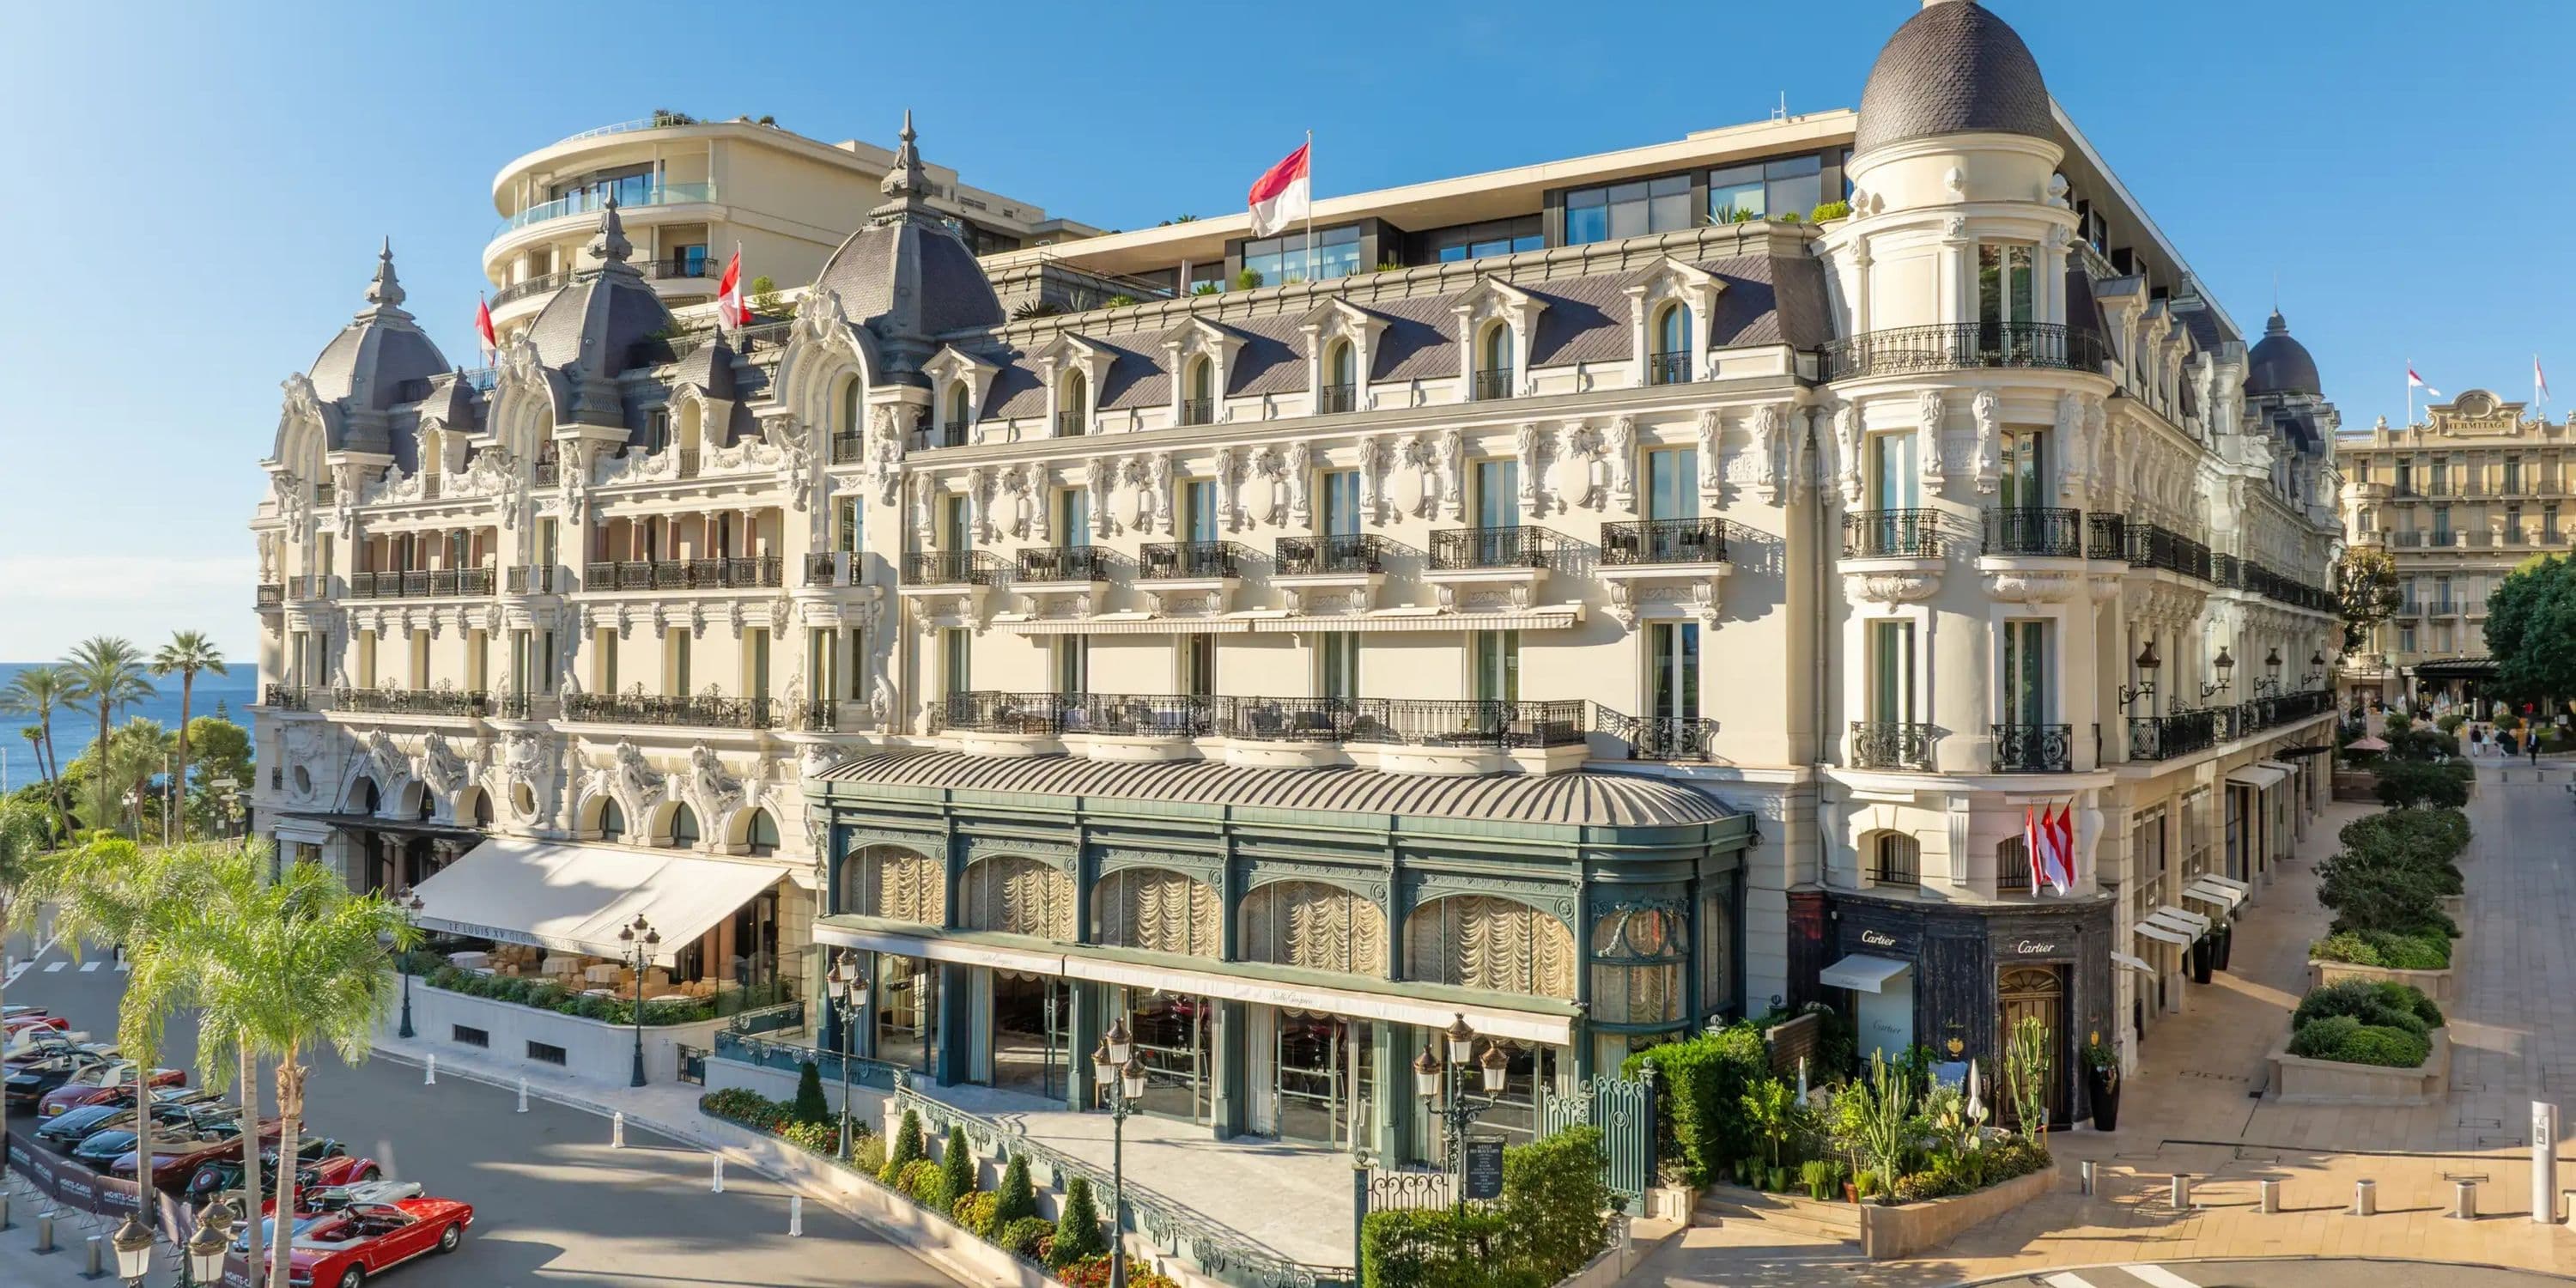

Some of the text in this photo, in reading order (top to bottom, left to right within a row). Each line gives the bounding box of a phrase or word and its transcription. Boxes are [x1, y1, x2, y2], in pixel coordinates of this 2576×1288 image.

[449, 922, 459, 932] LE
[464, 925, 489, 937] LOUIS
[494, 930, 505, 939] XV
[1862, 929, 1896, 946] Cartier
[2018, 939, 2055, 953] Cartier
[1873, 1018, 1902, 1035] Cartier
[103, 1190, 141, 1202] MONTE-CAR
[224, 1270, 251, 1287] MONTE-C
